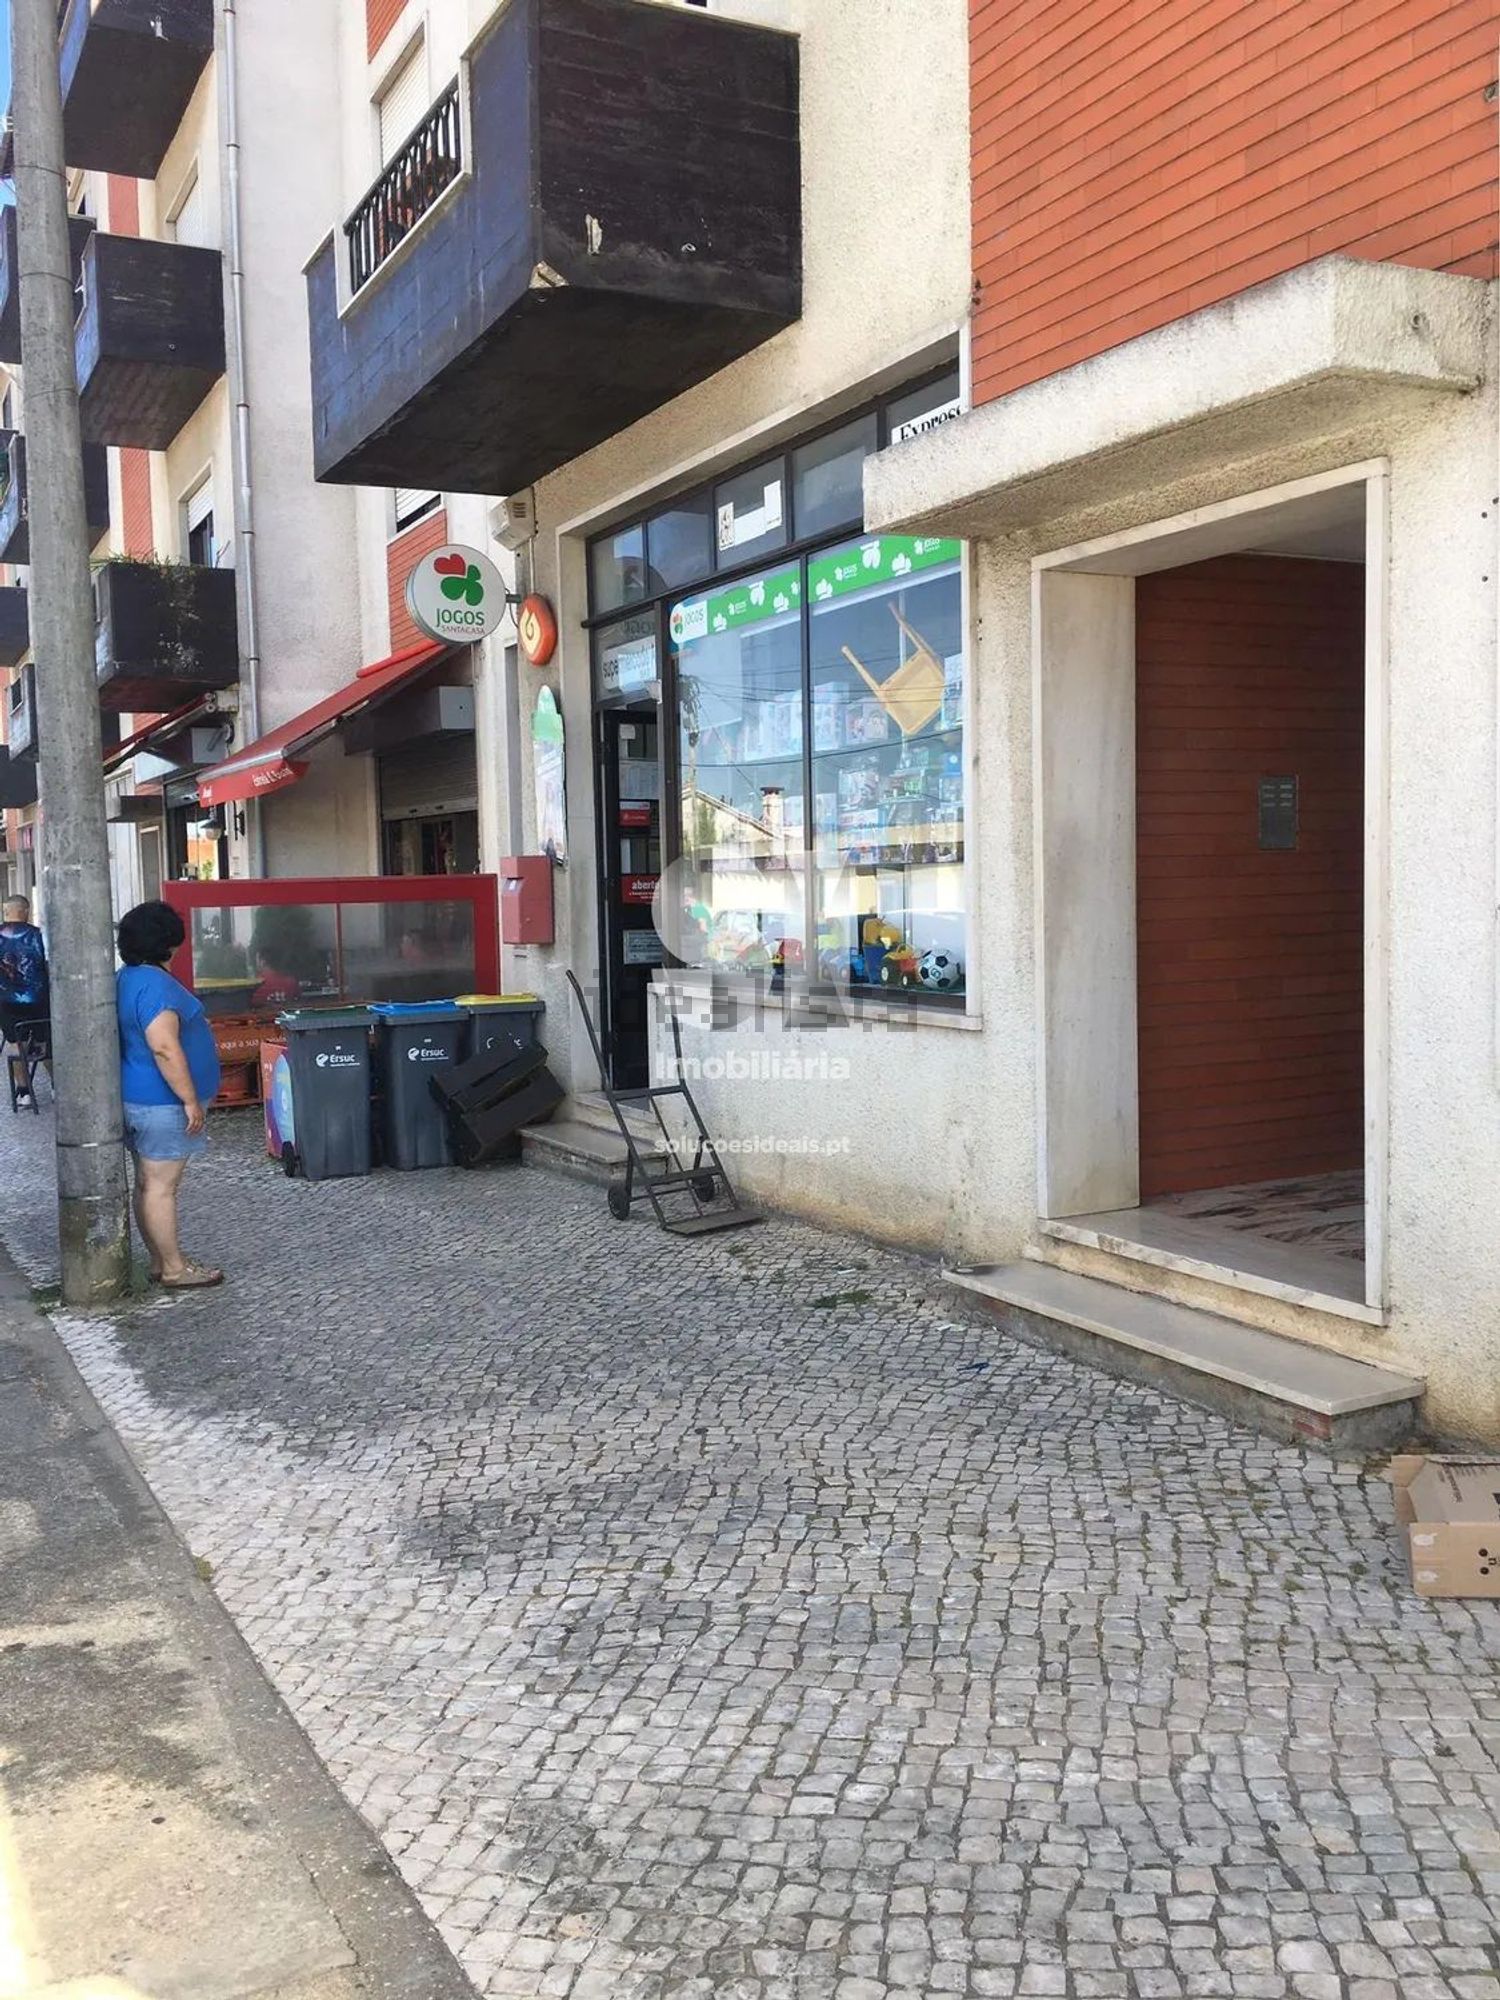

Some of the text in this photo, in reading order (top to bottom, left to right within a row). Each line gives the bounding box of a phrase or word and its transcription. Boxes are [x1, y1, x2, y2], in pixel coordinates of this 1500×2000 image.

[436, 608, 485, 627] JOGOS
[684, 607, 704, 627] JOGOS
[329, 1054, 356, 1063] Ersuc
[420, 1048, 445, 1058] Ersuc
